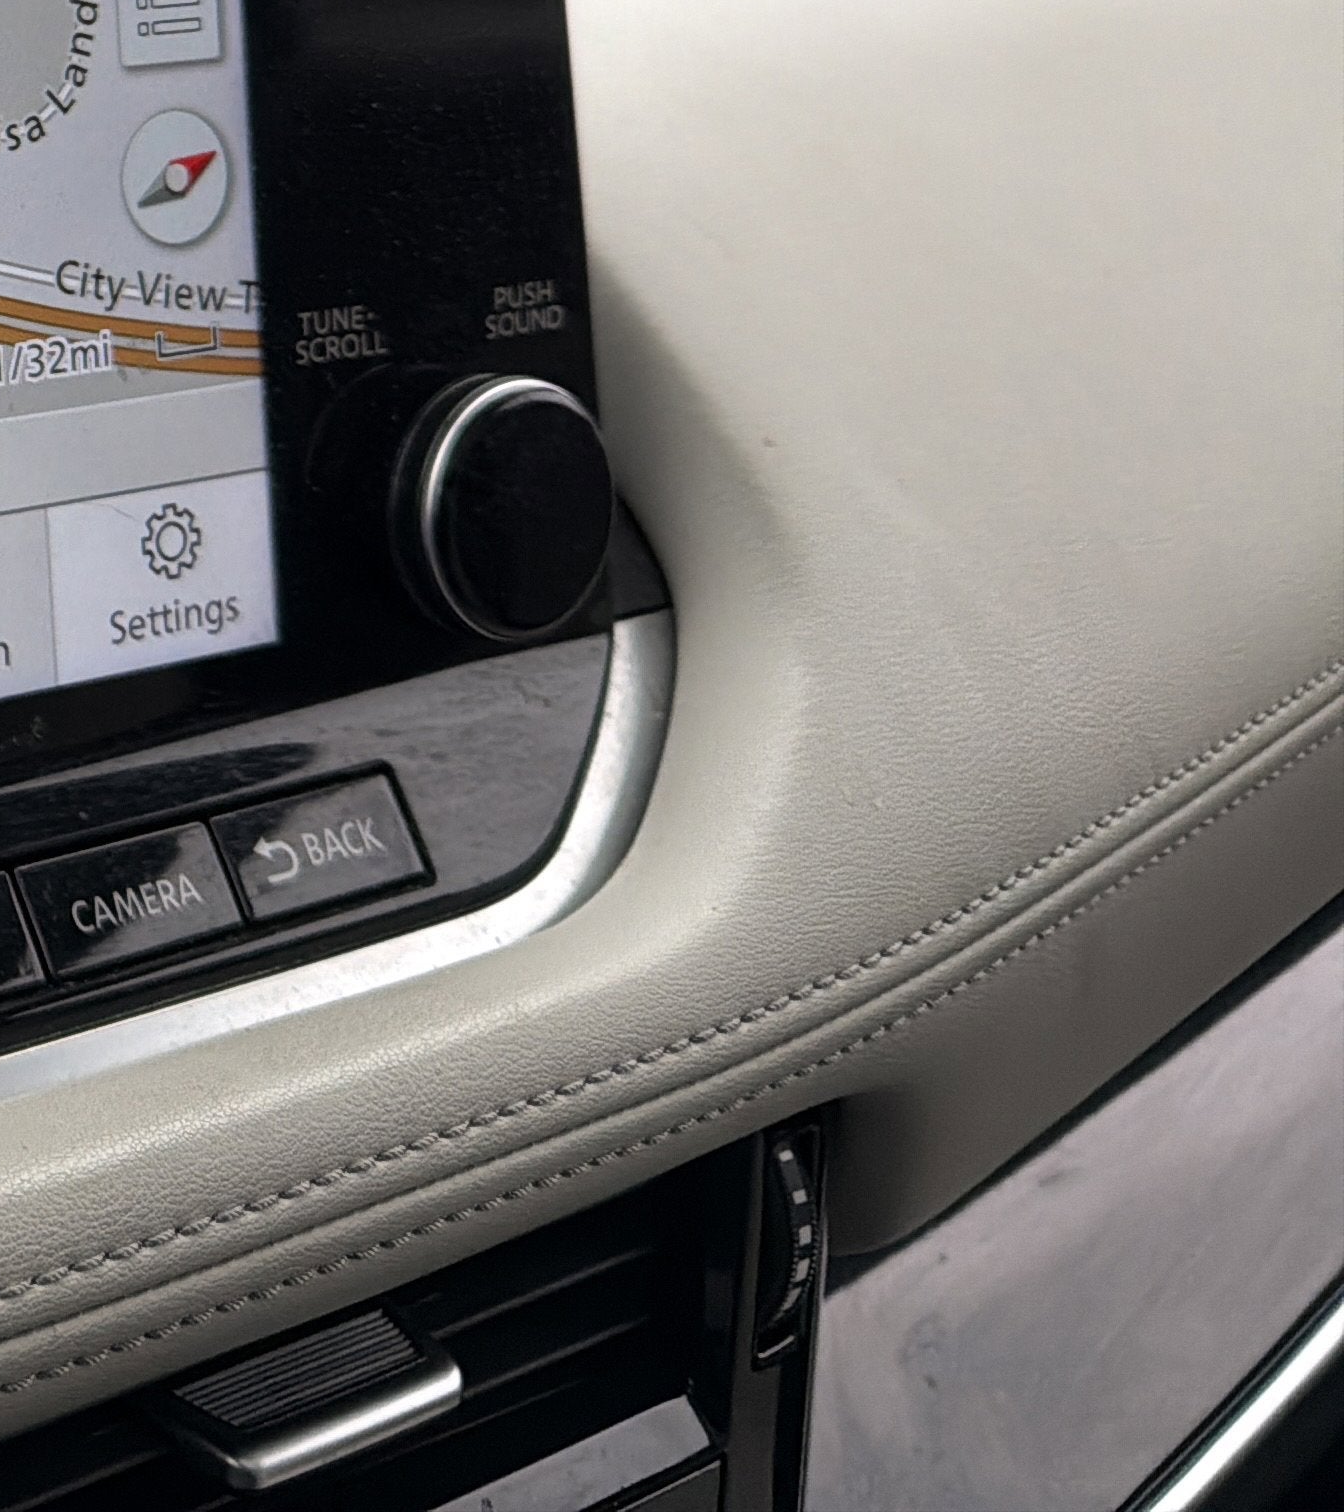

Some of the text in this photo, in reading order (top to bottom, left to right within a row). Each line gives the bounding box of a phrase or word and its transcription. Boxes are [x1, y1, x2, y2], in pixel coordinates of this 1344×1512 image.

[55, 259, 126, 311] City
[137, 269, 227, 312] View
[493, 278, 556, 311] PUSH
[484, 304, 567, 340] SOUND
[295, 331, 389, 366] SCROLL
[109, 594, 240, 644] Settings
[301, 815, 384, 866] BACK
[70, 870, 204, 937] CAMERA
